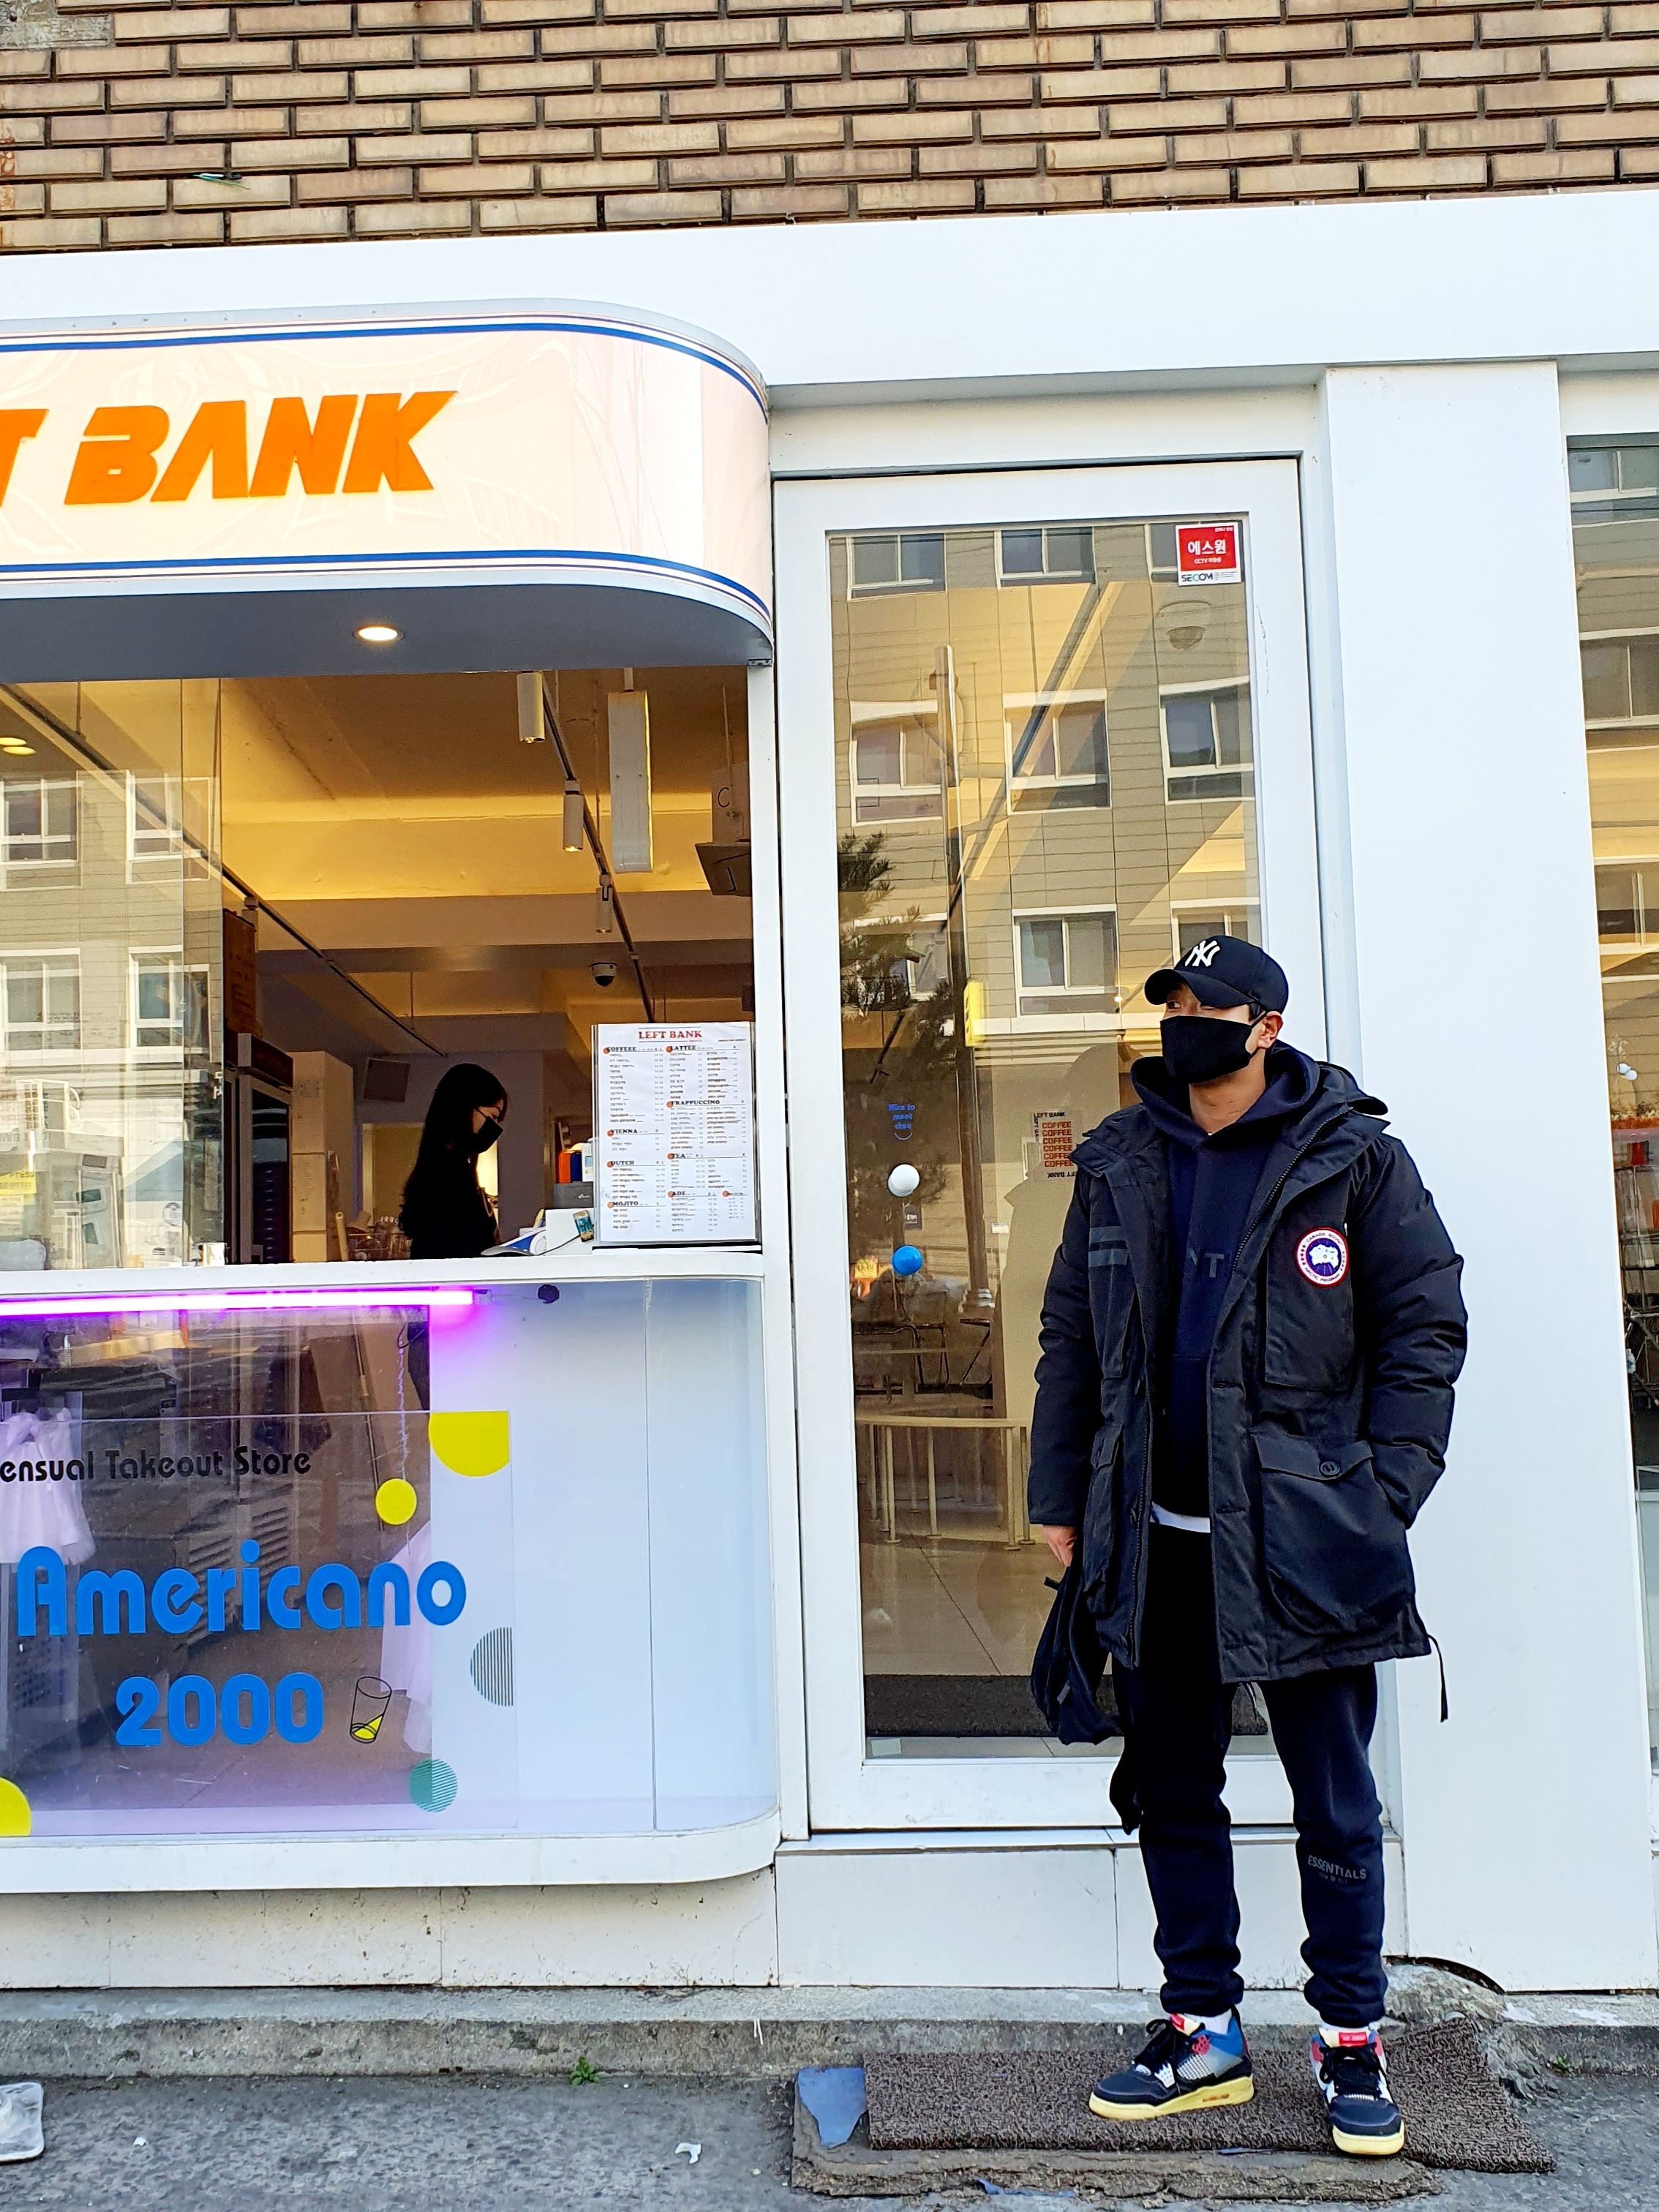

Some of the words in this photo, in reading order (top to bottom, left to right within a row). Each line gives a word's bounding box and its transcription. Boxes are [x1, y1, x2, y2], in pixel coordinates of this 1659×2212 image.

[64, 390, 458, 505] BANK
[1187, 539, 1227, 556] 에스원
[1181, 573, 1214, 582] SECOM
[1184, 940, 1221, 967] NY
[638, 1030, 667, 1039] LEFT
[669, 1029, 703, 1039] BANK
[1042, 1121, 1072, 1129] COFFEE
[1306, 1232, 1325, 1243] CANADA
[1304, 1267, 1320, 1281] ARCTIC
[0, 1450, 94, 1483] ensual
[105, 1448, 223, 1479] Takeout
[234, 1445, 312, 1476] Store
[17, 1539, 467, 1637] Americano
[115, 1671, 325, 1748] 2000
[1307, 1854, 1367, 1880] ESSENTIALS
